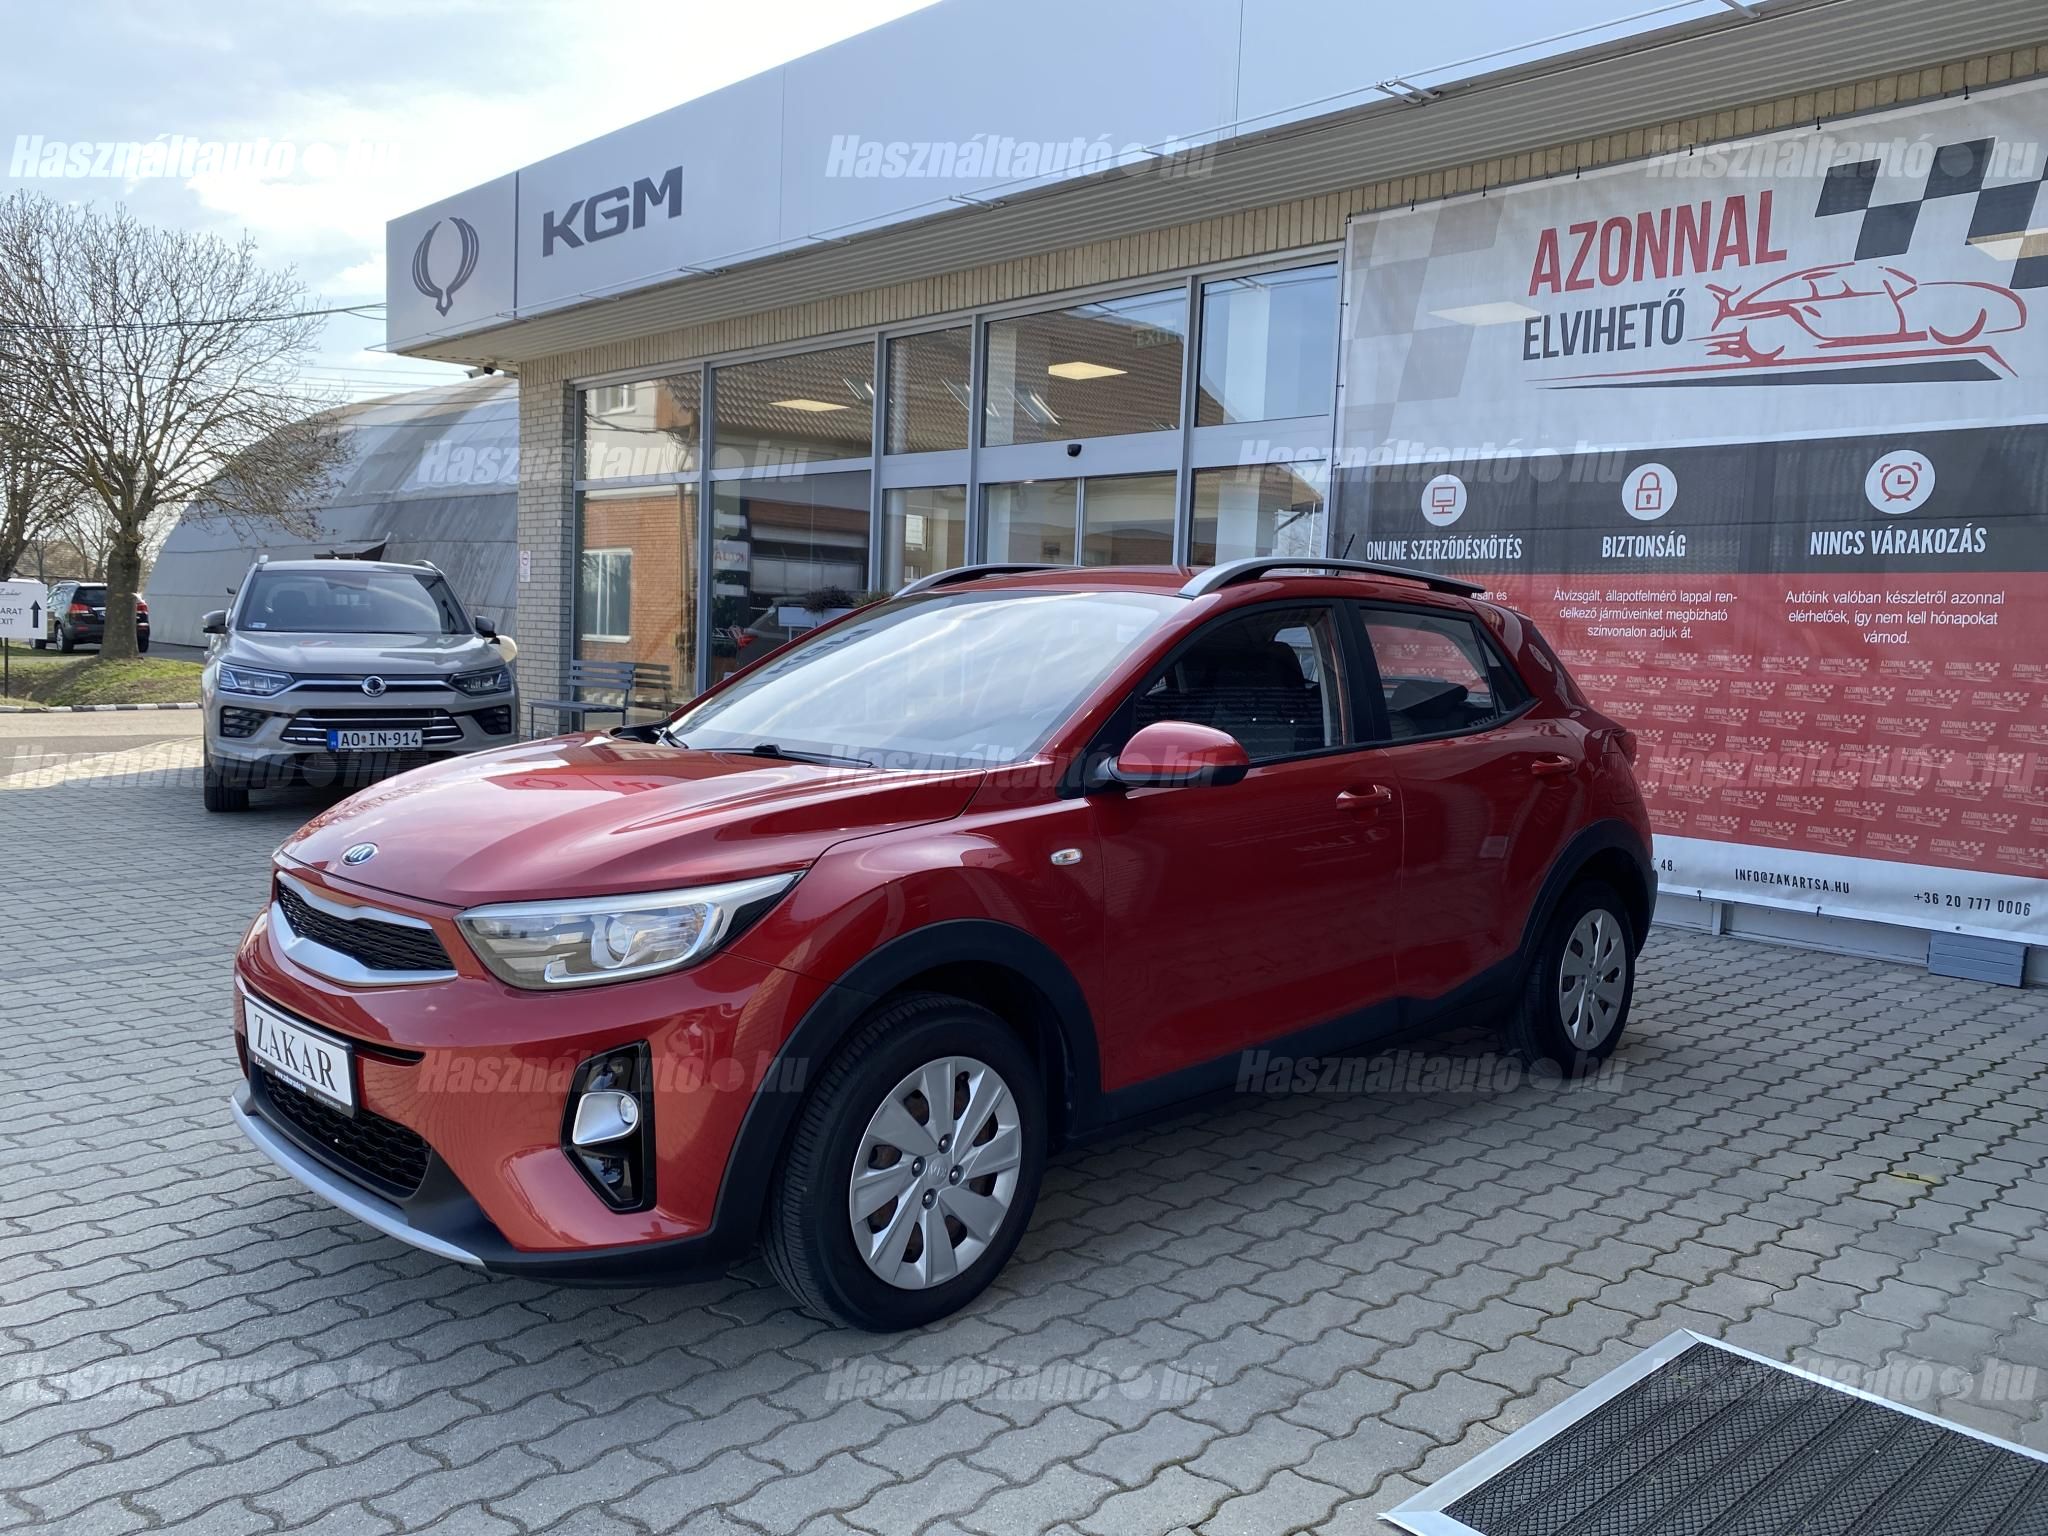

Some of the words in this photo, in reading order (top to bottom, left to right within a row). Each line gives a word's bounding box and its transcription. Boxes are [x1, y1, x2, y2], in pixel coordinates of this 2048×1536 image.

[542, 165, 685, 258] KGM
[1529, 190, 1787, 297] AZONNAL
[1523, 288, 1686, 361] ELVIHETŐ
[1366, 539, 1407, 561] ONLINE
[1411, 534, 1523, 560] SZERZŐDÉSKÖTÉS
[1602, 531, 1687, 559] BIZTONSÁG
[1810, 530, 1865, 555] NINCS
[1871, 522, 1988, 554] VÁRAKOZÁS
[1553, 587, 1602, 604] Átvizsgált,
[1605, 589, 1677, 605] állapotfelmérő
[1680, 590, 1712, 605] lappal
[1714, 592, 1738, 603] ren-
[1785, 590, 1829, 604] Autóink
[1833, 590, 1881, 604] valóban
[1885, 590, 1947, 604] készletről
[1951, 590, 2005, 605] azonnal
[1559, 607, 1597, 619] delkező
[1599, 608, 1663, 622] járműveinket
[1666, 607, 1728, 623] megbízható
[1788, 610, 1850, 625] elérhetőek,
[1854, 612, 1872, 627] így
[1875, 614, 1903, 624] nem
[1906, 611, 1926, 624] kell
[1930, 612, 1998, 628] hónapokat
[1587, 625, 1648, 639] színvonalon
[1650, 626, 1678, 641] adjuk
[1680, 627, 1694, 639] át.
[1863, 631, 1910, 644] várnod.
[341, 732, 361, 746] AO
[368, 732, 419, 746] IN-914
[1660, 858, 1677, 873] 48.
[1735, 868, 1850, 894] INFO@ZAKARTSA.HU
[1914, 892, 1940, 906] +36
[1946, 894, 1962, 909] 20
[1968, 896, 1991, 912] 777
[1997, 899, 2031, 917] 0006
[254, 1013, 338, 1094] ZAKAR
